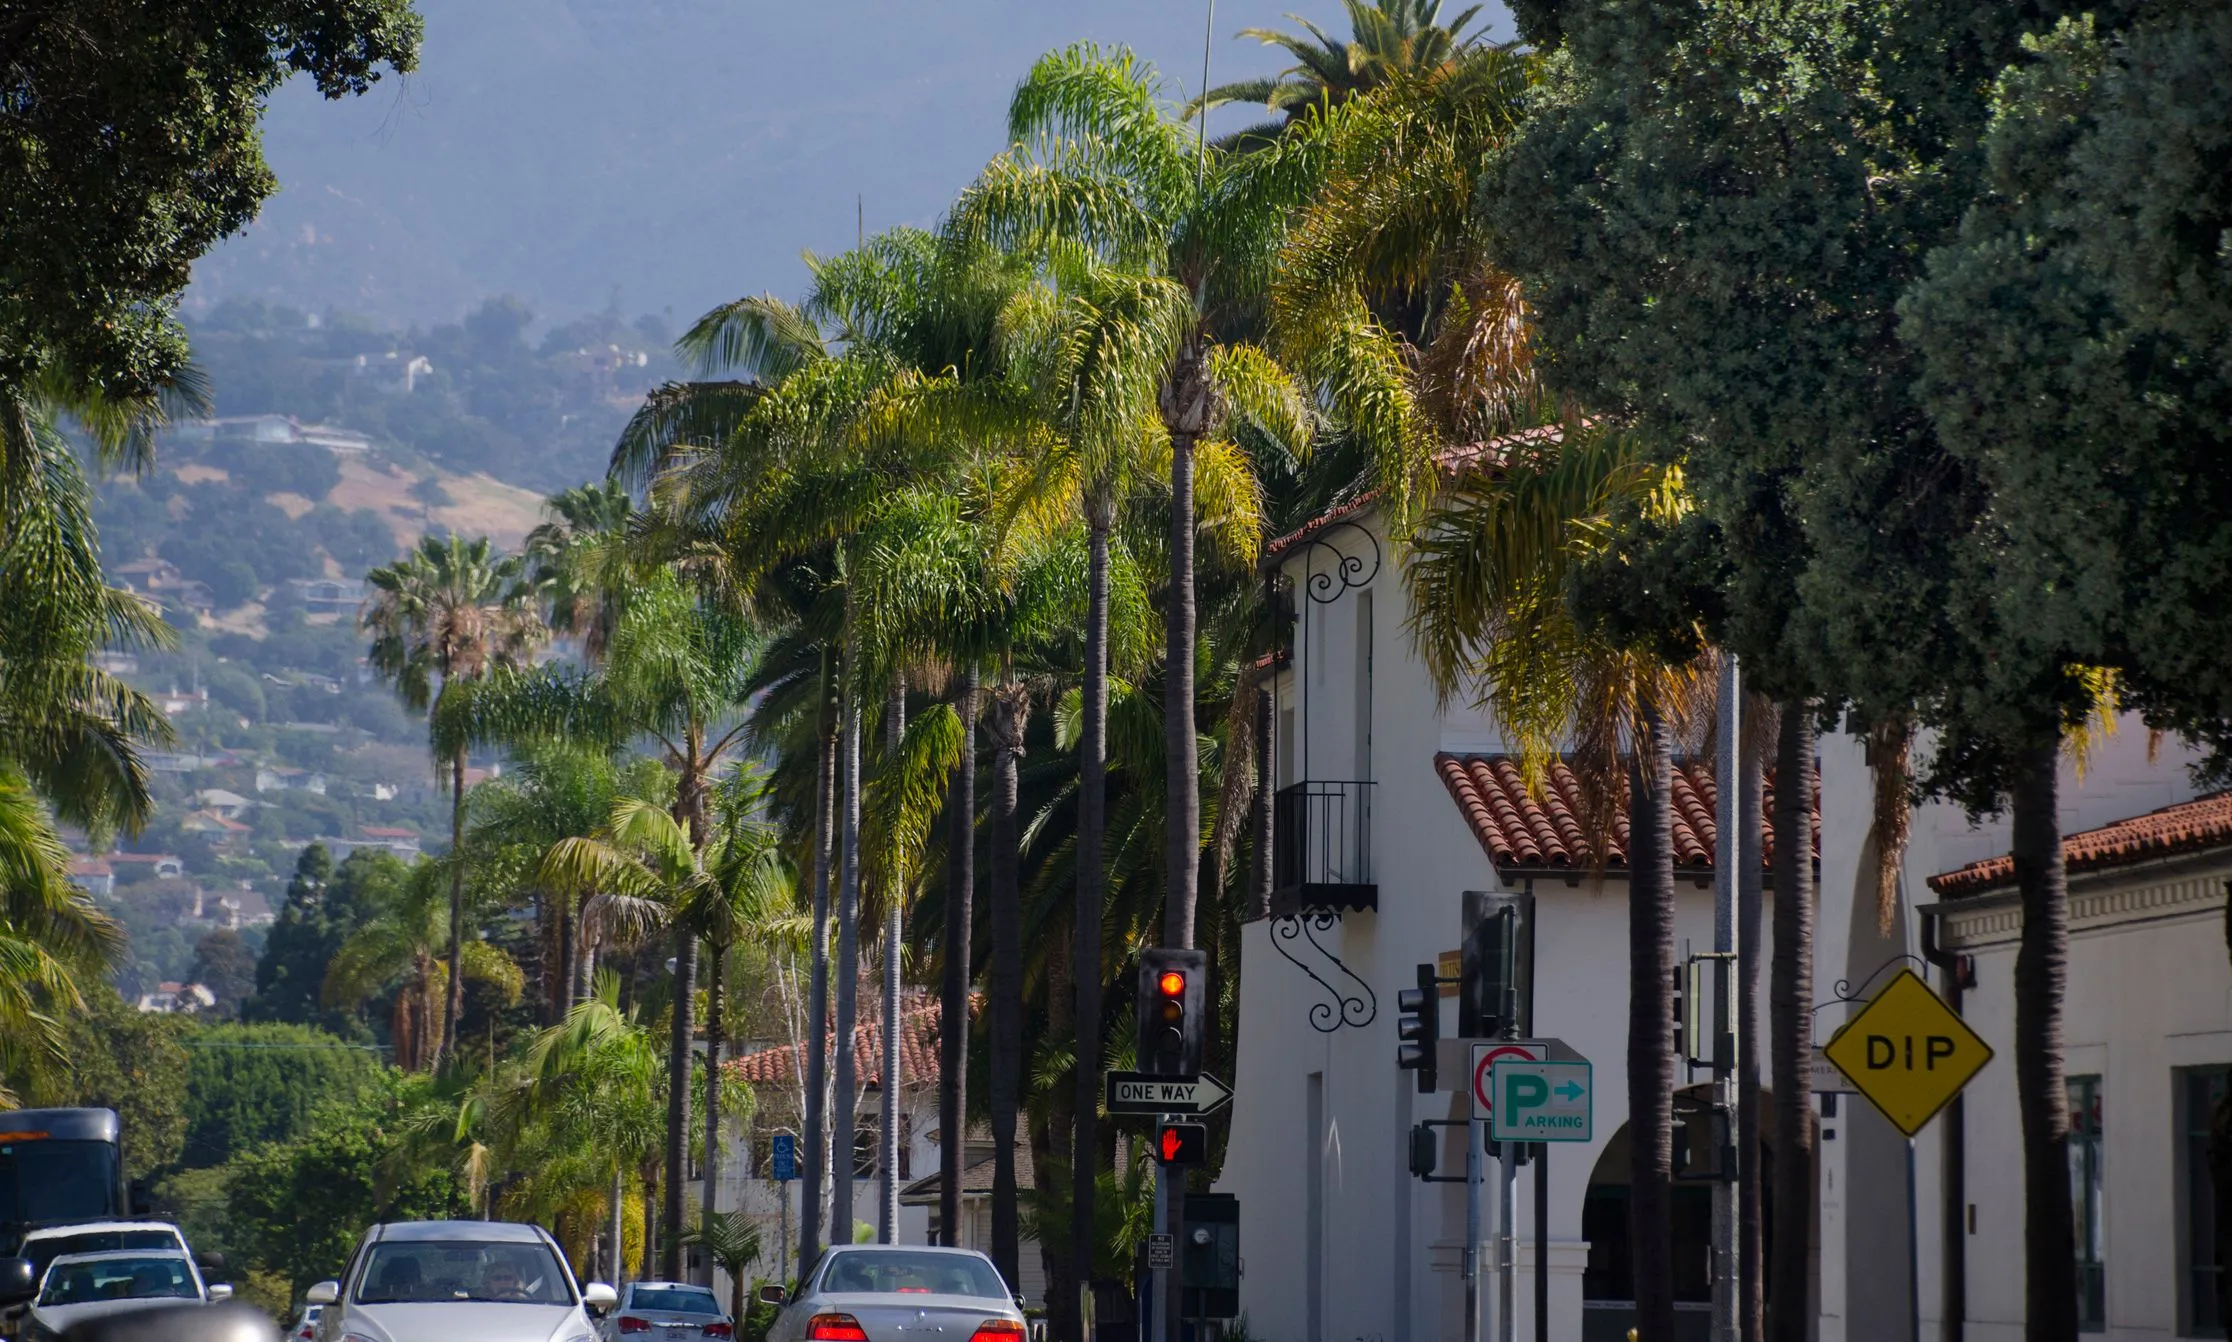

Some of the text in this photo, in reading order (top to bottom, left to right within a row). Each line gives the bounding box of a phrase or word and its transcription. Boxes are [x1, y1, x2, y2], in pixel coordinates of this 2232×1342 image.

[1867, 1035, 1955, 1070] DIP
[1121, 1085, 1195, 1100] ONE WAY
